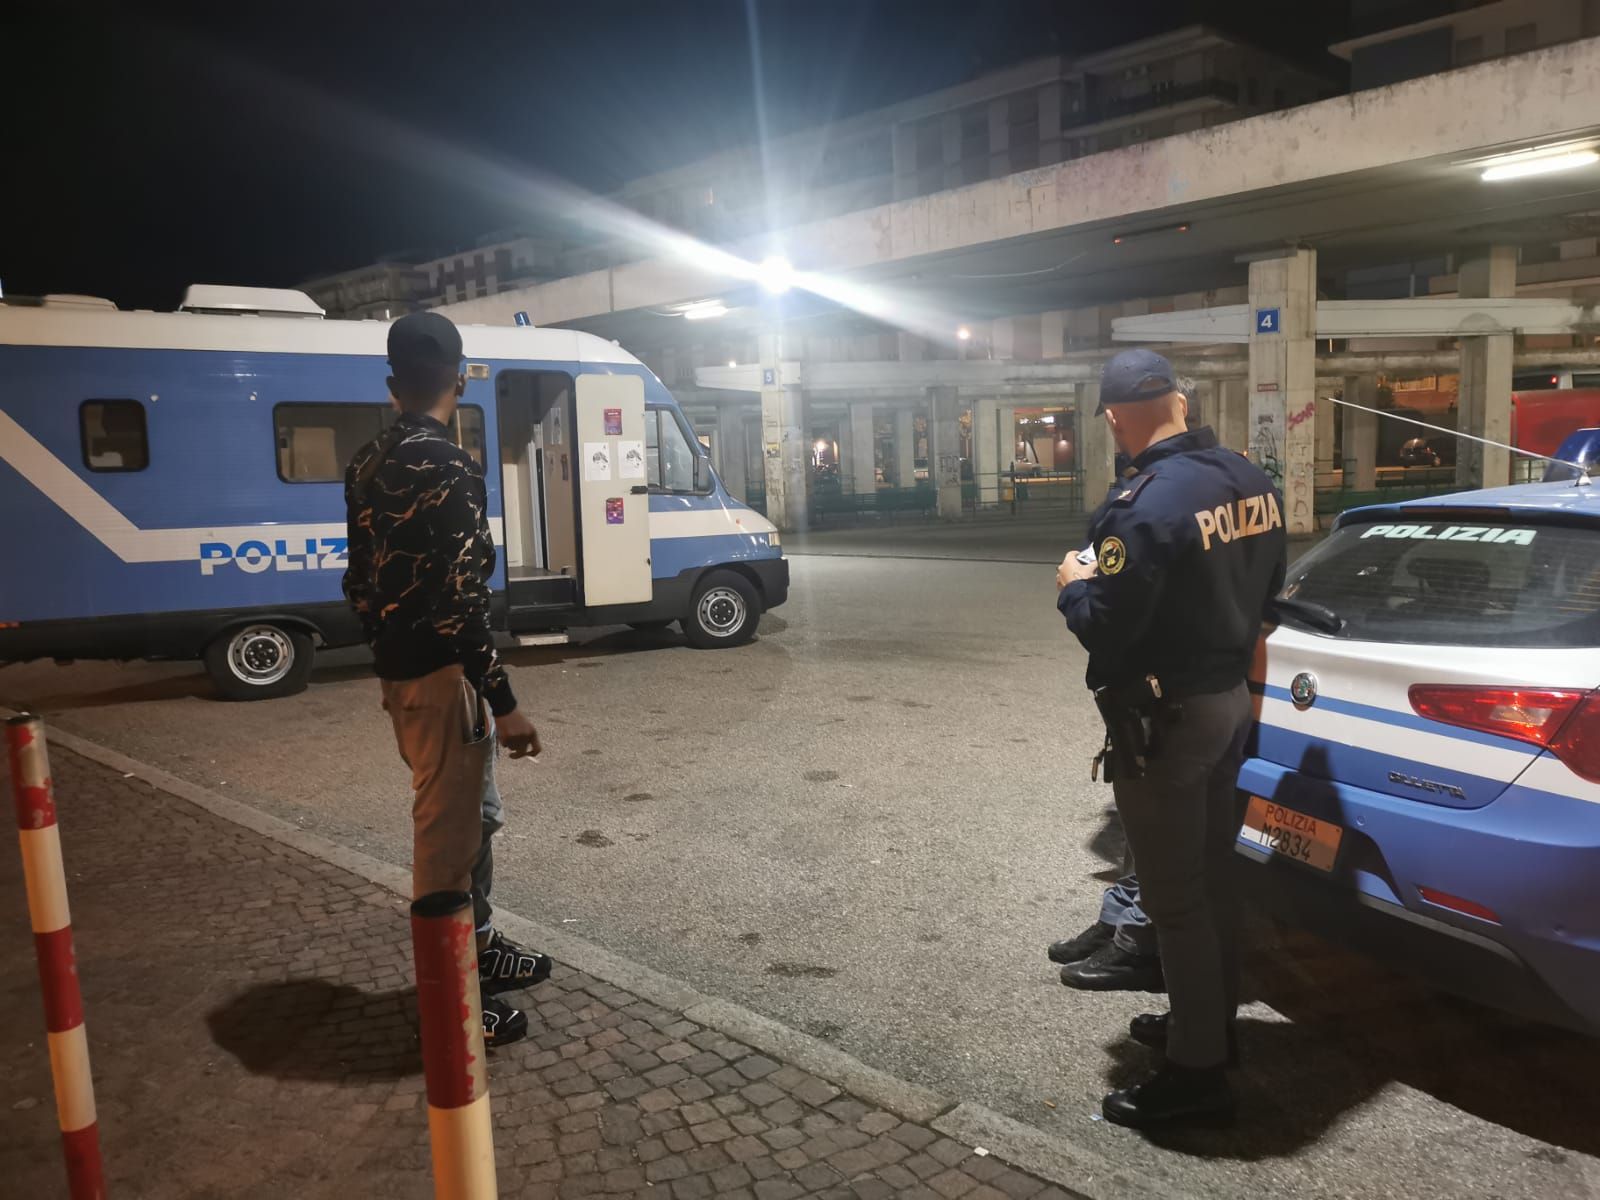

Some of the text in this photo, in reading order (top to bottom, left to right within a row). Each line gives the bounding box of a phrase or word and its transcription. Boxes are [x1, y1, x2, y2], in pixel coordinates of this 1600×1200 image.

[1261, 314, 1273, 328] 4
[1195, 492, 1282, 551] POLIZIA
[1360, 525, 1537, 545] POLIZIA
[1265, 804, 1317, 836] POLIZIA
[1260, 822, 1312, 861] M2834
